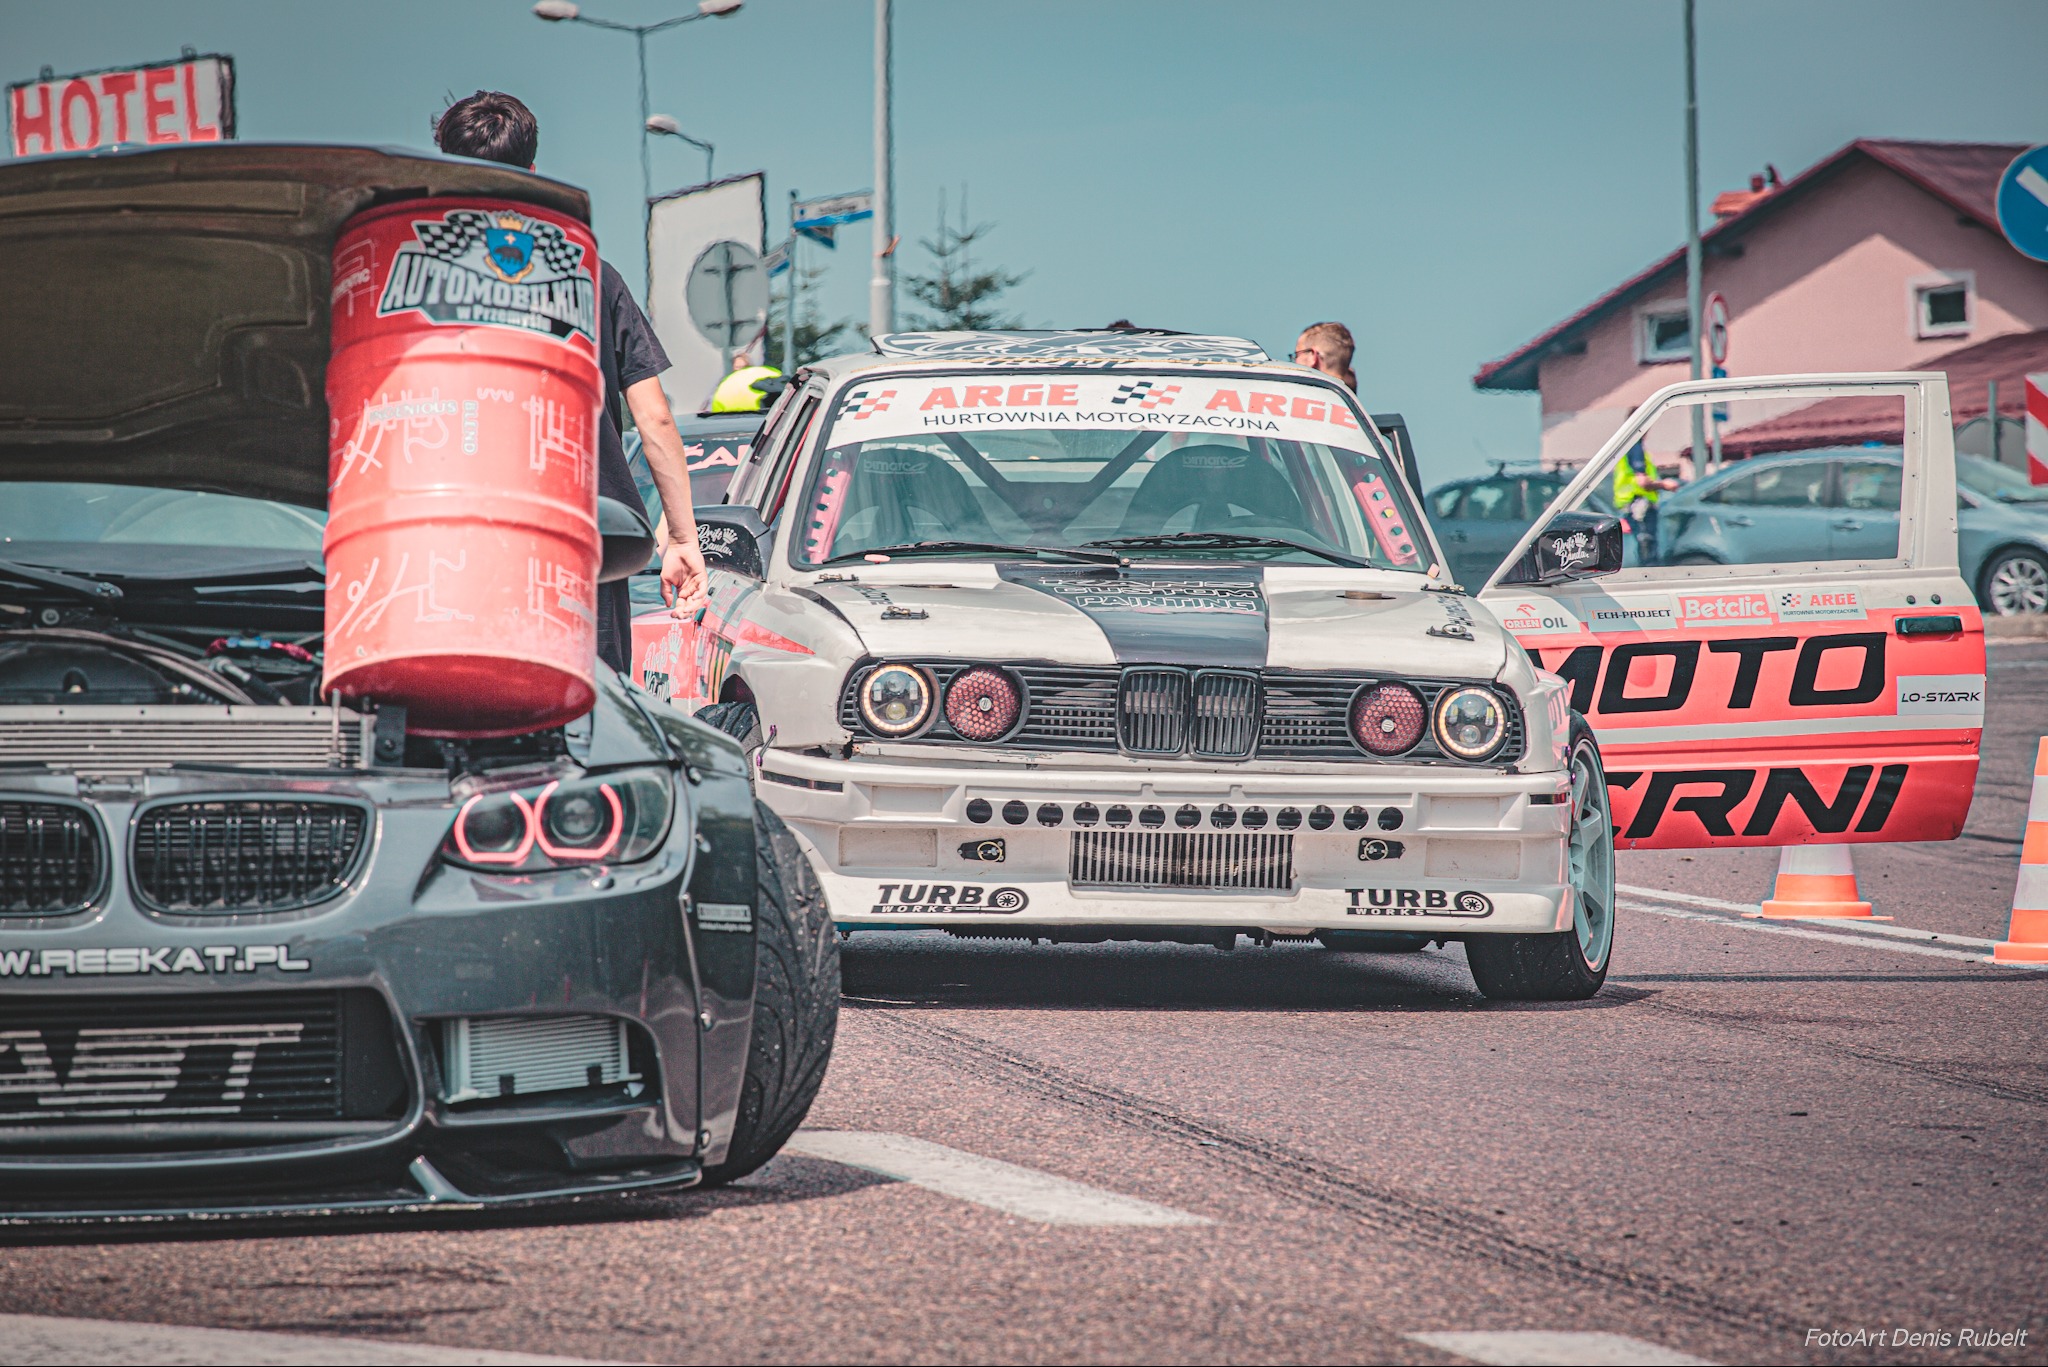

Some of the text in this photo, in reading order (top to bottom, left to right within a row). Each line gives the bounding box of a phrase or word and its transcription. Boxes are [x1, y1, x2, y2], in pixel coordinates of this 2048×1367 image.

[11, 64, 221, 157] HOTEL
[919, 384, 1079, 411] ARGE
[1205, 389, 1359, 430] ARGE
[463, 400, 478, 455] BLEND
[923, 411, 1281, 432] HURTOWNIA MOTORYZACYJNA
[1054, 586, 1258, 598] CUSTOM
[1076, 596, 1257, 611] PAINTING
[1685, 596, 1767, 618] Betclic
[1810, 593, 1857, 607] ARGE
[1588, 609, 1671, 620] TECH-PROJECT
[1505, 617, 1568, 629] ORLEN OIL
[1901, 691, 1981, 703] LO-STARK
[881, 905, 953, 913] WORKS
[1355, 907, 1425, 916] WORKS
